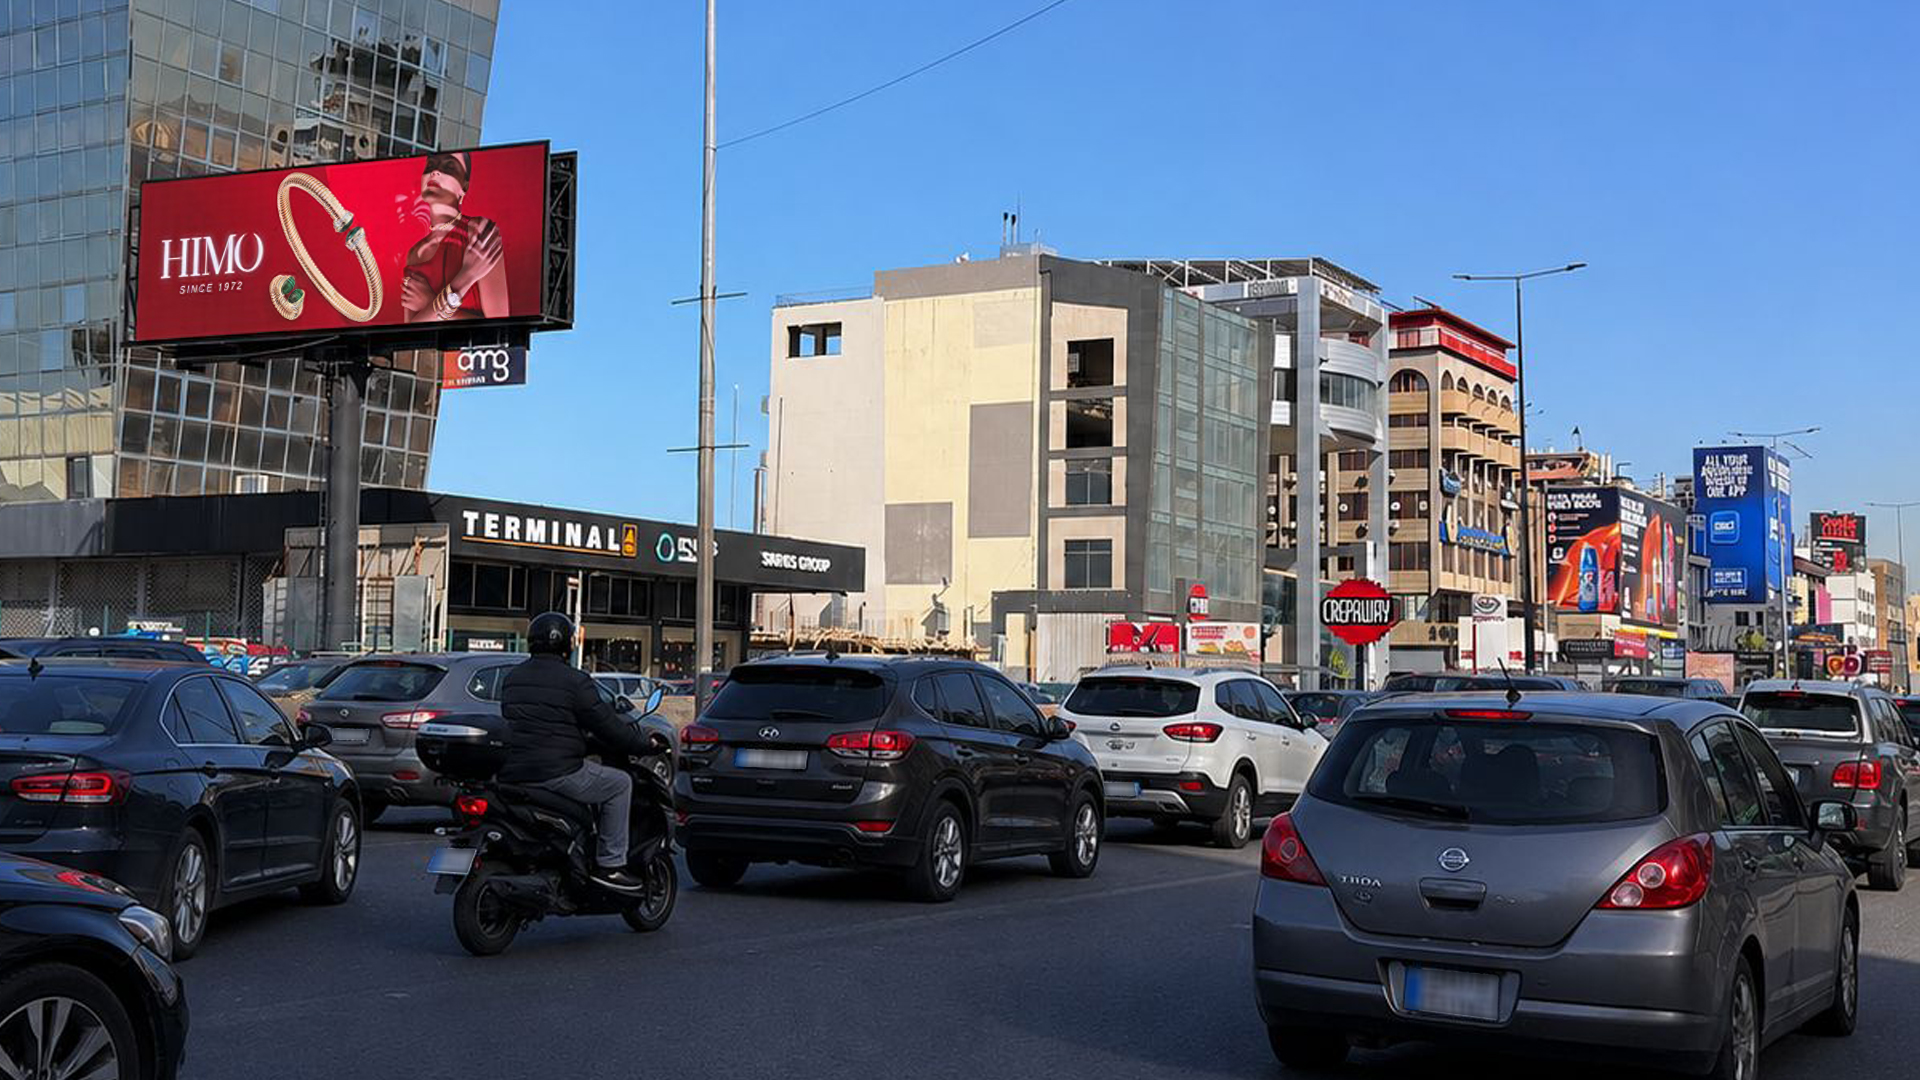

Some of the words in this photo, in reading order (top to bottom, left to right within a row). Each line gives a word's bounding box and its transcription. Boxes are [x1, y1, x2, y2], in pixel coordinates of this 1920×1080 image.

[161, 233, 264, 279] HIMO
[179, 283, 213, 295] SINCE
[218, 281, 243, 292] 1972
[458, 349, 509, 382] amg
[462, 510, 621, 551] TERMINAL
[1323, 599, 1390, 623] CREPAWAY
